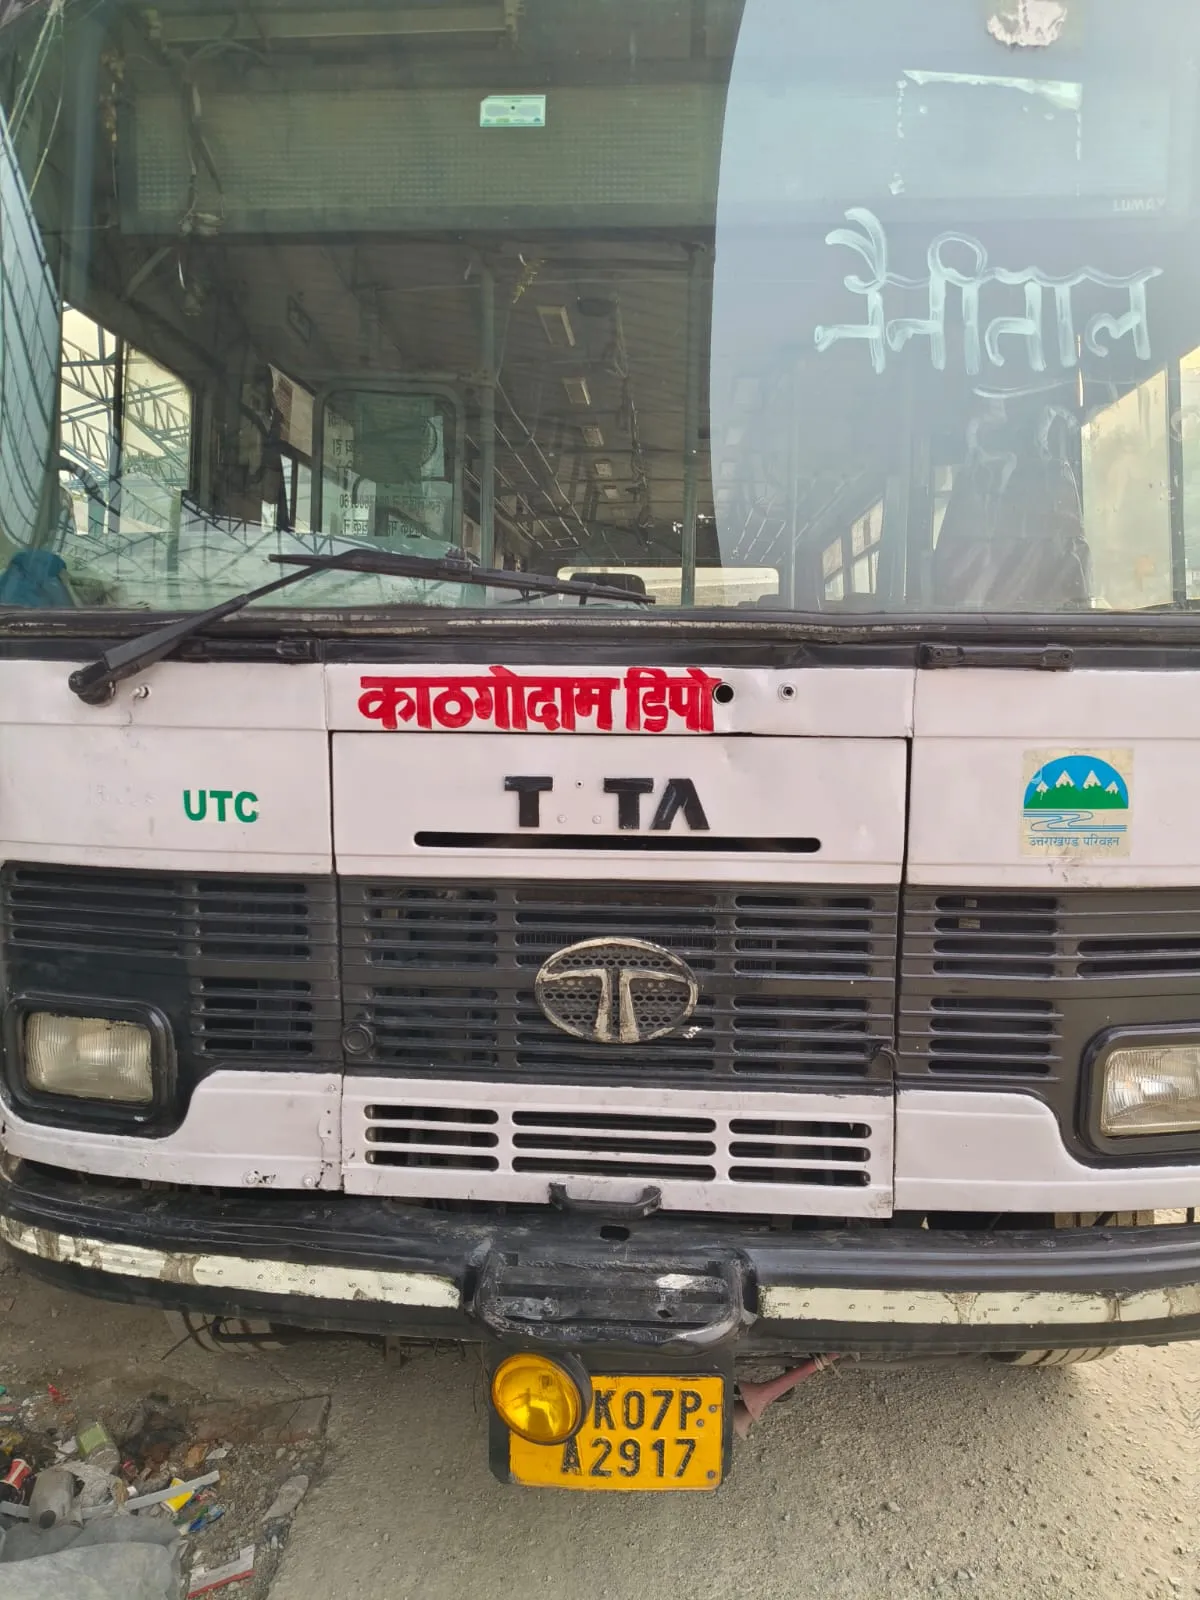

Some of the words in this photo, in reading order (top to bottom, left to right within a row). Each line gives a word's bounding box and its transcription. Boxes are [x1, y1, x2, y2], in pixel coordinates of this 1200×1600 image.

[813, 207, 1164, 374] नैनीताल
[358, 665, 620, 731] काठगोदाम
[623, 667, 722, 732] डिपो
[183, 789, 259, 823] UTC
[1083, 834, 1120, 847] परिवहन
[593, 1389, 703, 1431] K07P
[561, 1437, 696, 1477] A2917
